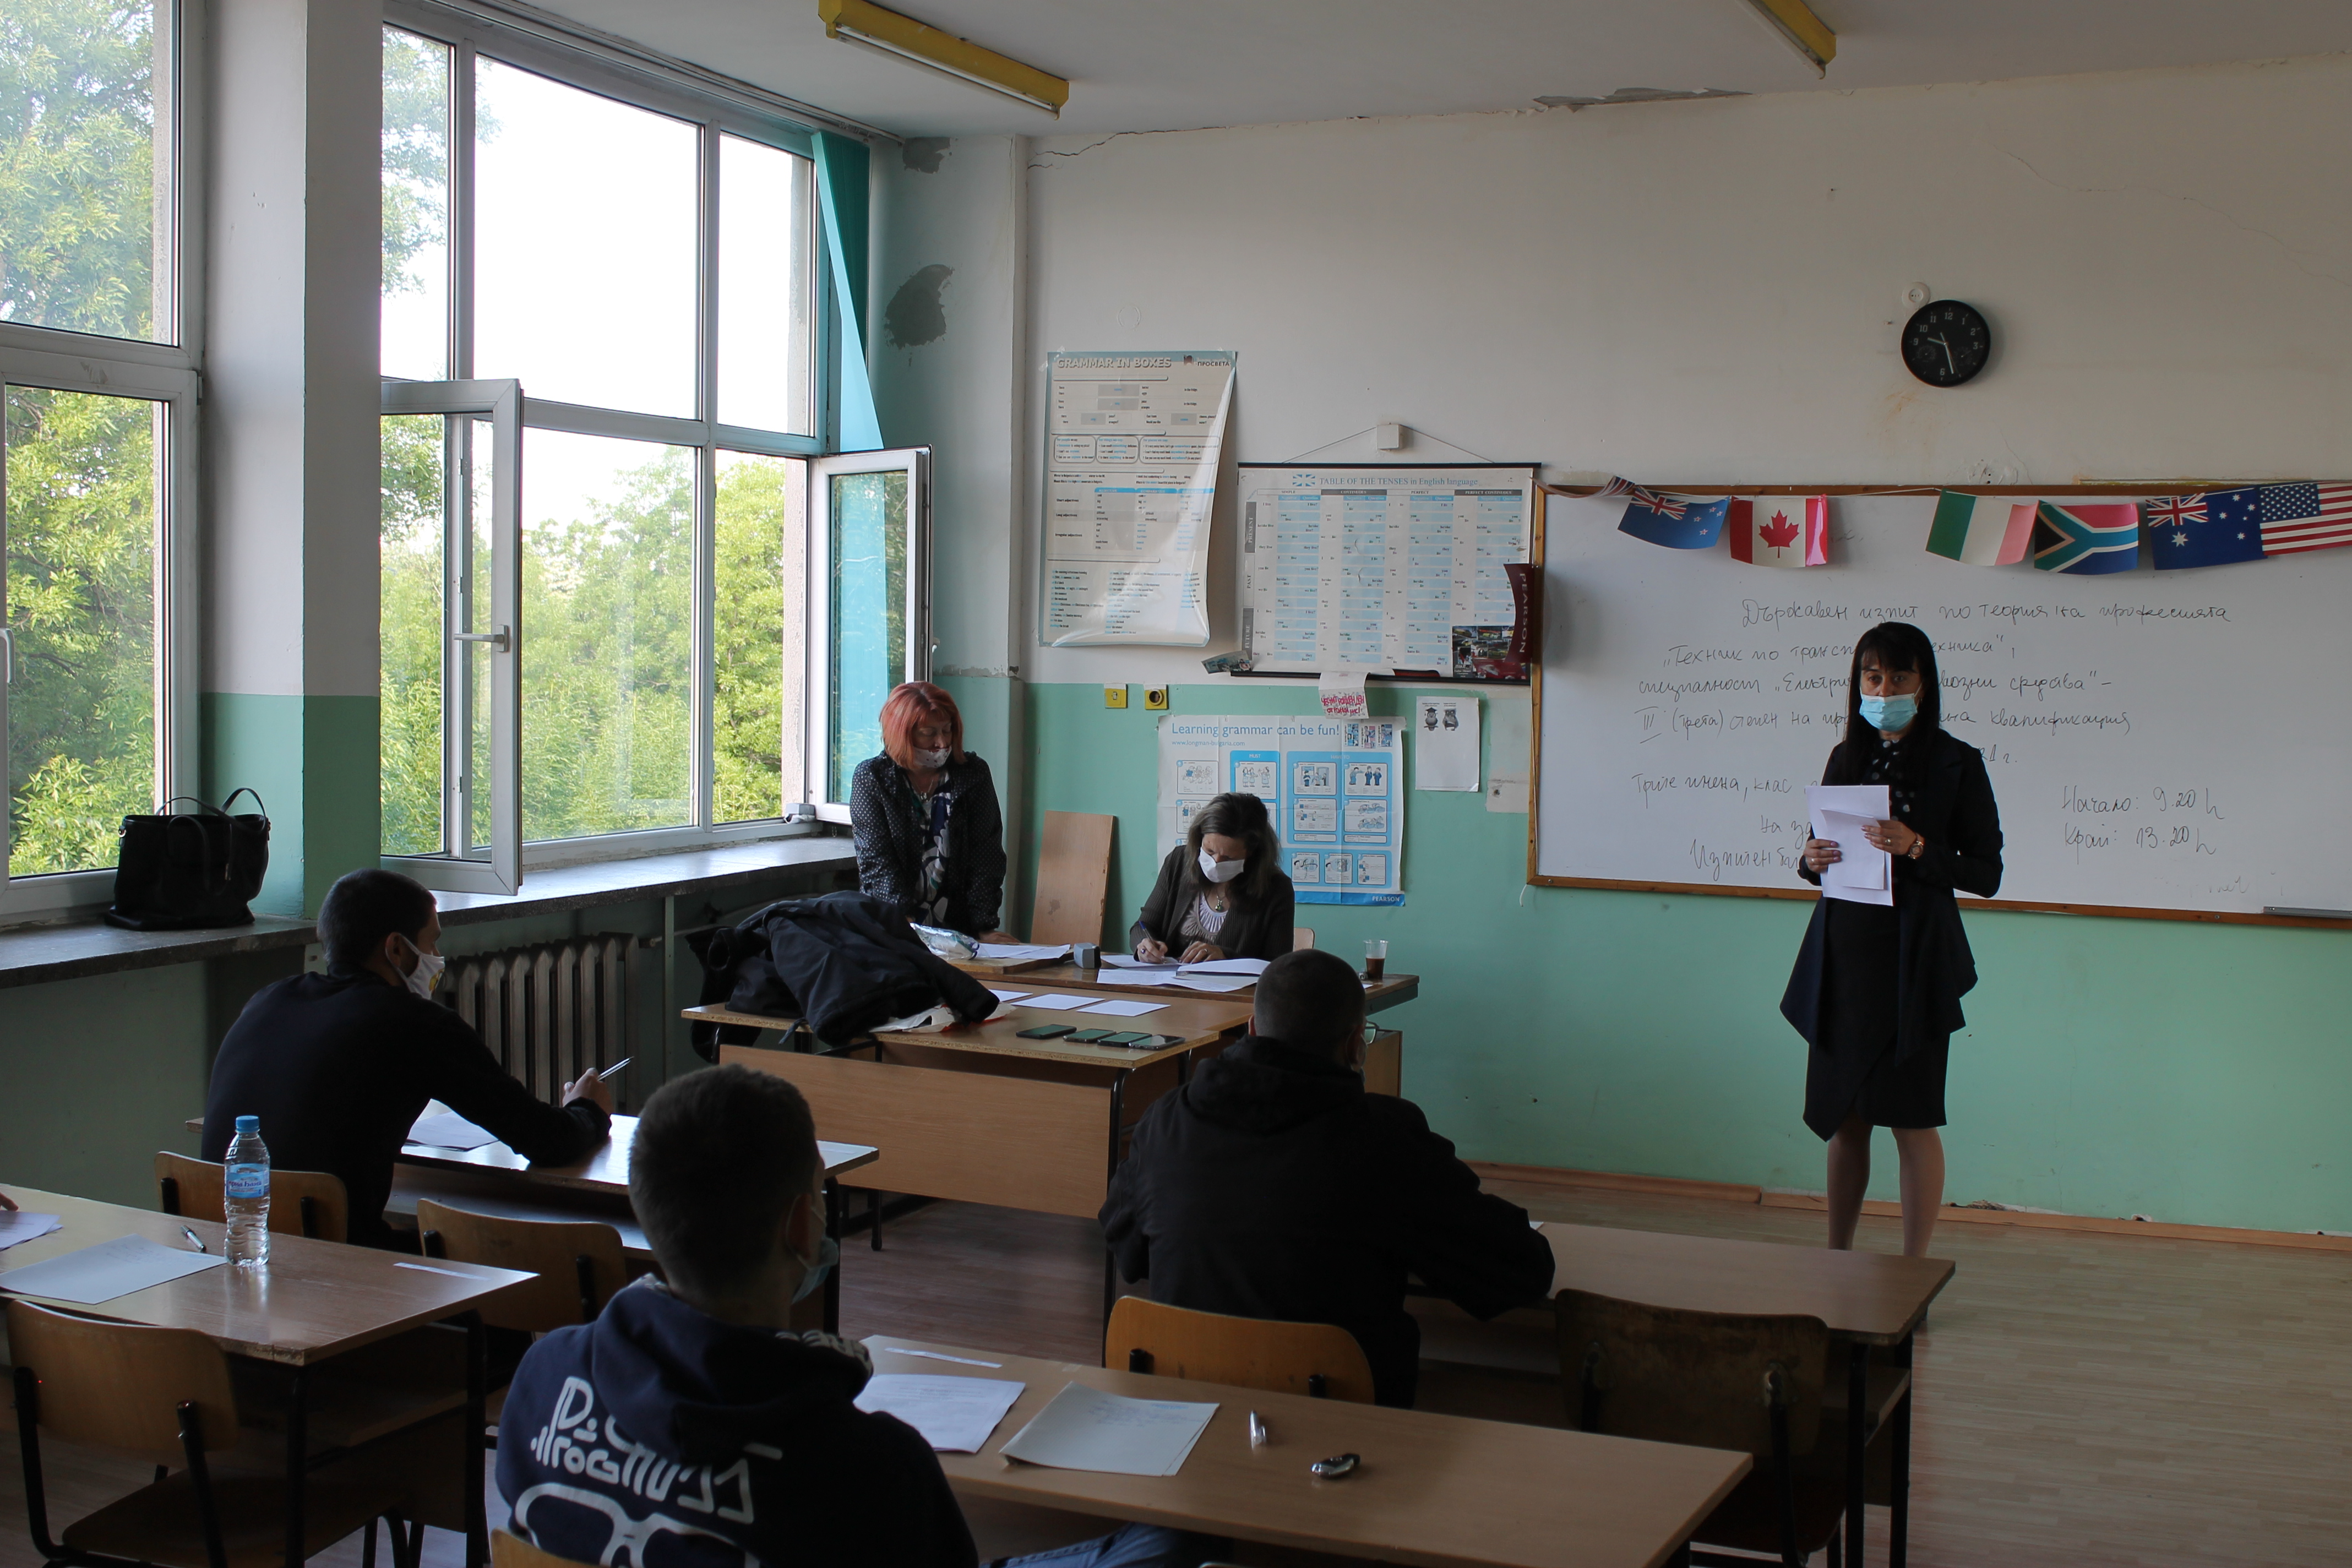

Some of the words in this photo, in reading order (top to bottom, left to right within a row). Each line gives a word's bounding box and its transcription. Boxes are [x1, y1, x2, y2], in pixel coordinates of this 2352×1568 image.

[1057, 357, 1113, 368] GRAMMAR
[1117, 357, 1130, 368] IN
[1133, 357, 1172, 368] BOXES
[1419, 478, 1445, 486] English
[1447, 478, 1478, 486] language
[1519, 573, 1528, 653] PEARSON
[1742, 598, 1848, 632] Държавен
[1859, 606, 1919, 623] изпит
[1939, 605, 1970, 620] по
[1978, 603, 2048, 626] теория
[2055, 606, 2085, 618] на
[2099, 603, 2231, 626] професията
[1751, 650, 1779, 661] по
[1790, 644, 1855, 665] трансп
[1638, 677, 1761, 702] специалност
[1774, 672, 1850, 698] „Електри
[1939, 670, 1997, 701] возни
[1172, 723, 1219, 737] Learning
[1222, 726, 1273, 737] grammar
[1277, 727, 1294, 735] can
[1300, 724, 1314, 735] be
[1318, 724, 1340, 735] fun!
[1673, 707, 1723, 741] (трета)
[1729, 714, 1778, 731] степен
[1791, 711, 1810, 726] на
[1990, 707, 2130, 736] квалификация
[1631, 772, 1678, 809] Трите
[1685, 775, 1748, 802] имена,
[1754, 777, 1793, 793] клас
[2061, 785, 2138, 813] Начало:
[2153, 786, 2196, 812] 9.20
[2205, 787, 2224, 819] h
[1689, 839, 1771, 881] Изпитен
[2064, 821, 2117, 865] Край:
[2136, 825, 2190, 848] 13.20
[2195, 827, 2217, 854] h
